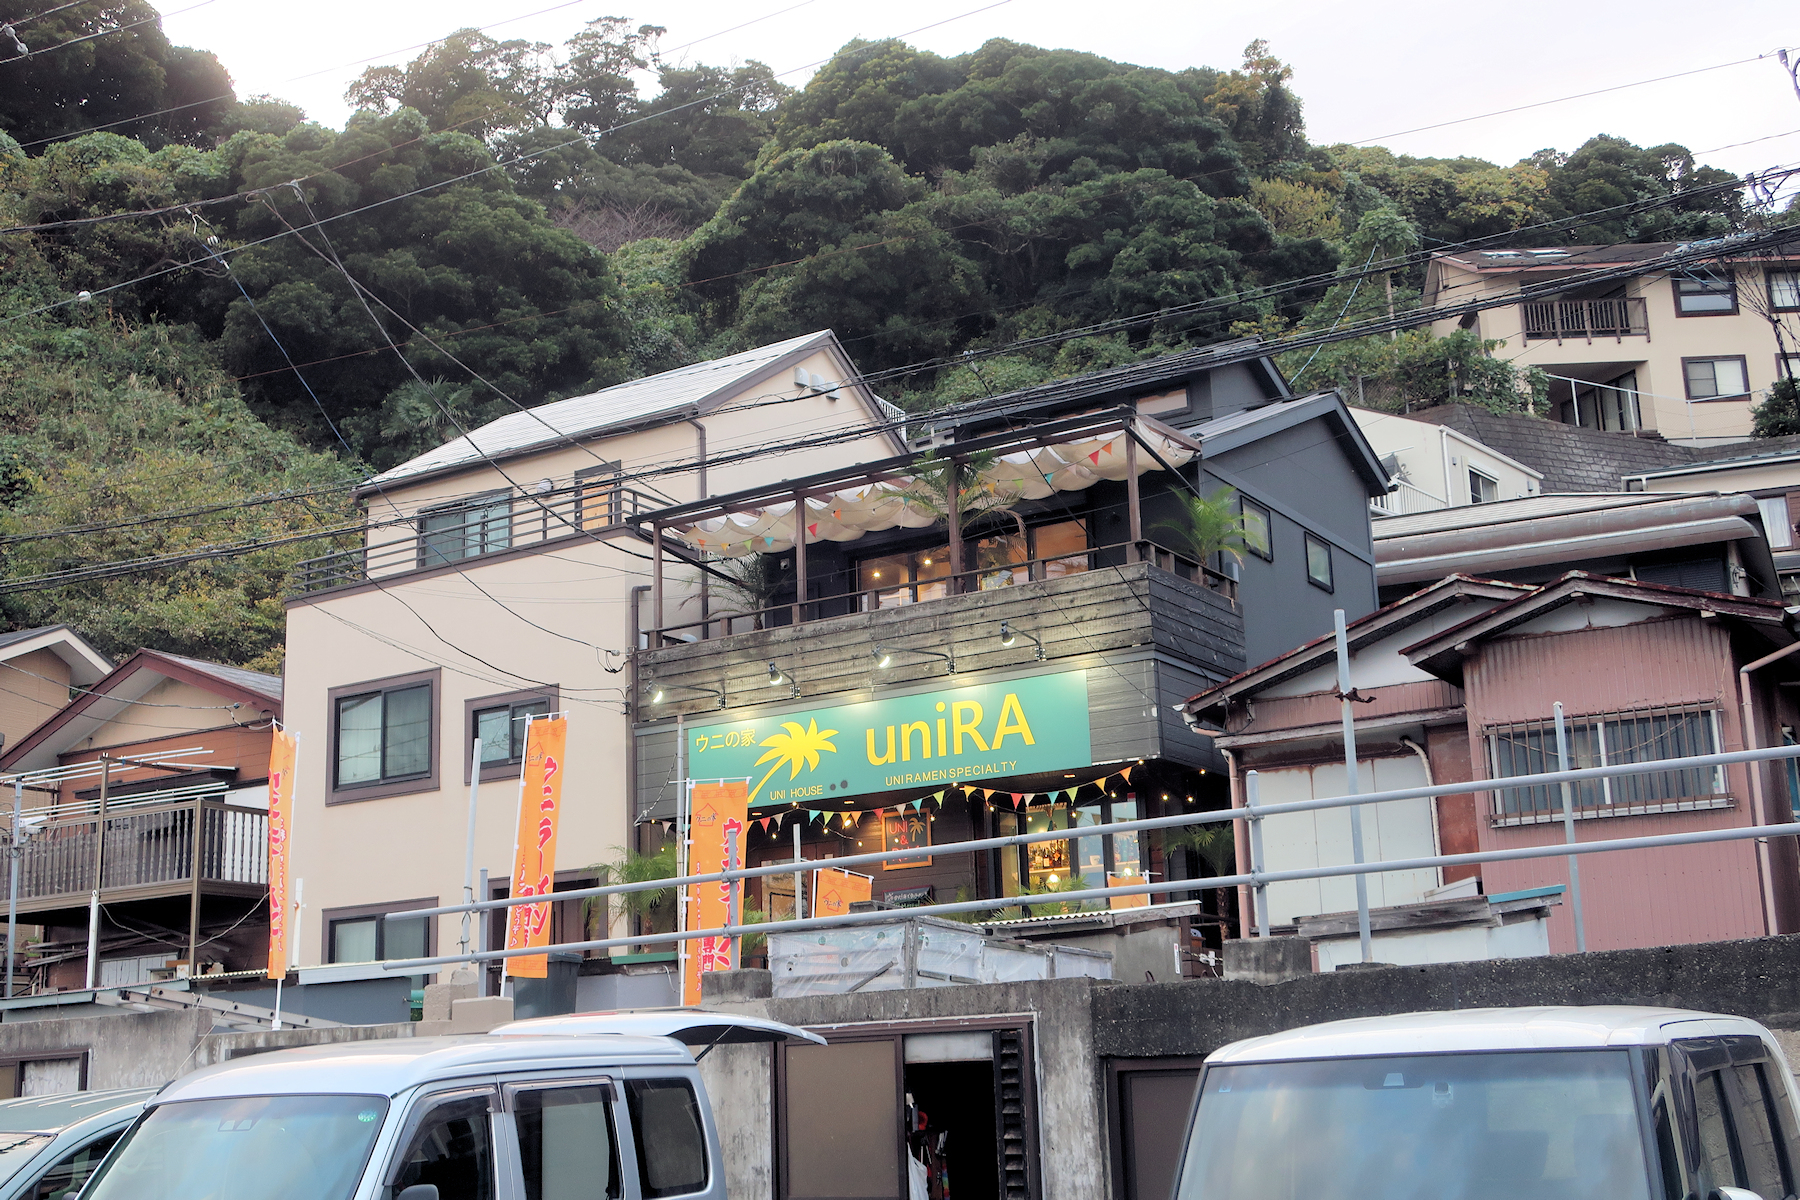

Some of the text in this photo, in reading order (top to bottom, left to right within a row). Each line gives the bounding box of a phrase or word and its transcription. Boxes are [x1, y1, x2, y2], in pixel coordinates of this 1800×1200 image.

[695, 727, 757, 753] ウニの家
[866, 693, 1036, 766] uniRA
[885, 760, 1018, 786] UNI RAMEN SPECIALTY
[769, 785, 824, 801] UNI HOUSE
[889, 820, 908, 835] UNI
[900, 834, 909, 846] &
